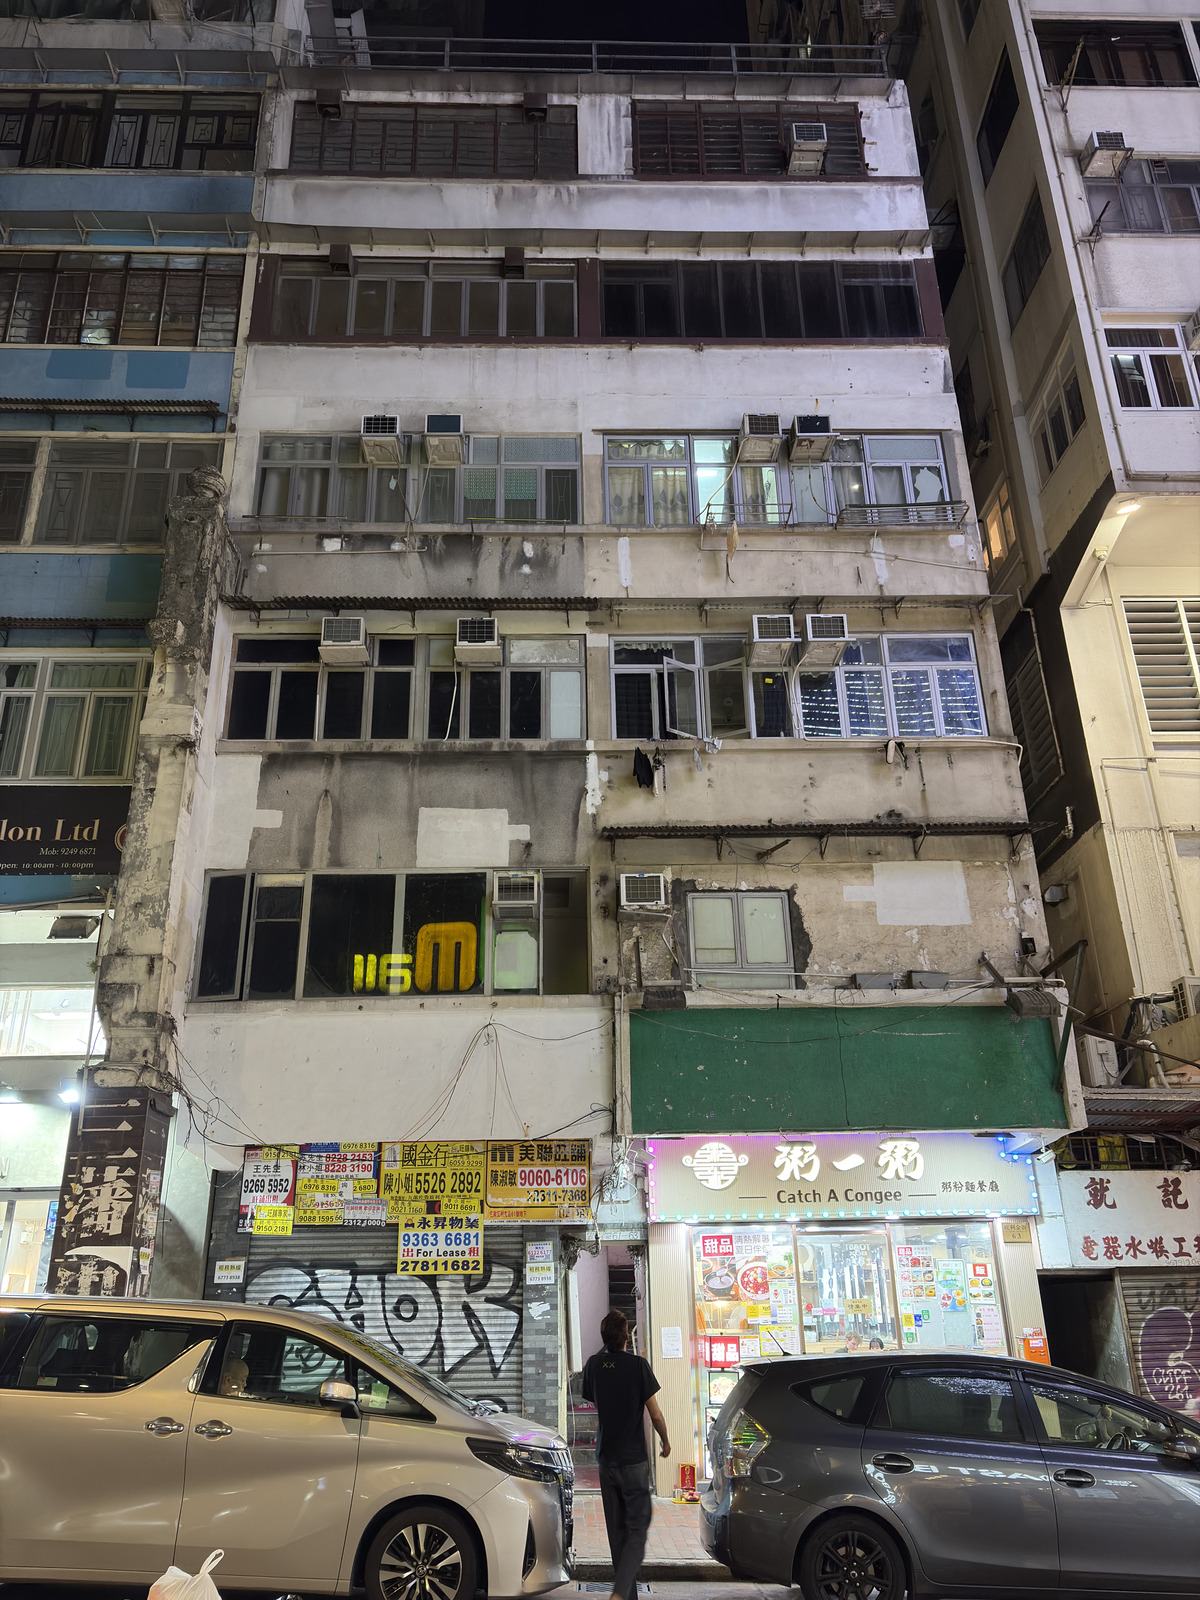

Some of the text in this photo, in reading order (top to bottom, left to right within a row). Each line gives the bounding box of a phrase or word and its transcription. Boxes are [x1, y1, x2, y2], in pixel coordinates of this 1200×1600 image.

[52, 818, 100, 841] Ltd
[39, 847, 96, 855] Mob: 9249 6871
[0, 862, 18, 870] pen:
[402, 1143, 449, 1168] 國金行
[324, 1163, 347, 1173] 8228
[349, 1163, 373, 1173] 3190
[383, 1171, 481, 1195] 陳小姐 5526 2892
[519, 1168, 587, 1187] 9060-6106
[243, 1178, 290, 1193] 9269 5952
[358, 1184, 375, 1192] 6801
[776, 1188, 902, 1204] Catch A Congee
[390, 1205, 423, 1214] 9021 1160
[274, 1225, 288, 1233] 2181
[417, 1216, 480, 1230] 永昇物業
[402, 1232, 479, 1247] 9363 6681
[703, 1238, 733, 1254] 甜品
[416, 1249, 433, 1257] For
[436, 1248, 466, 1257] Lease
[1080, 1235, 1200, 1261] 電器水喉工
[399, 1260, 481, 1272] 27811682
[975, 1265, 986, 1276] 飯
